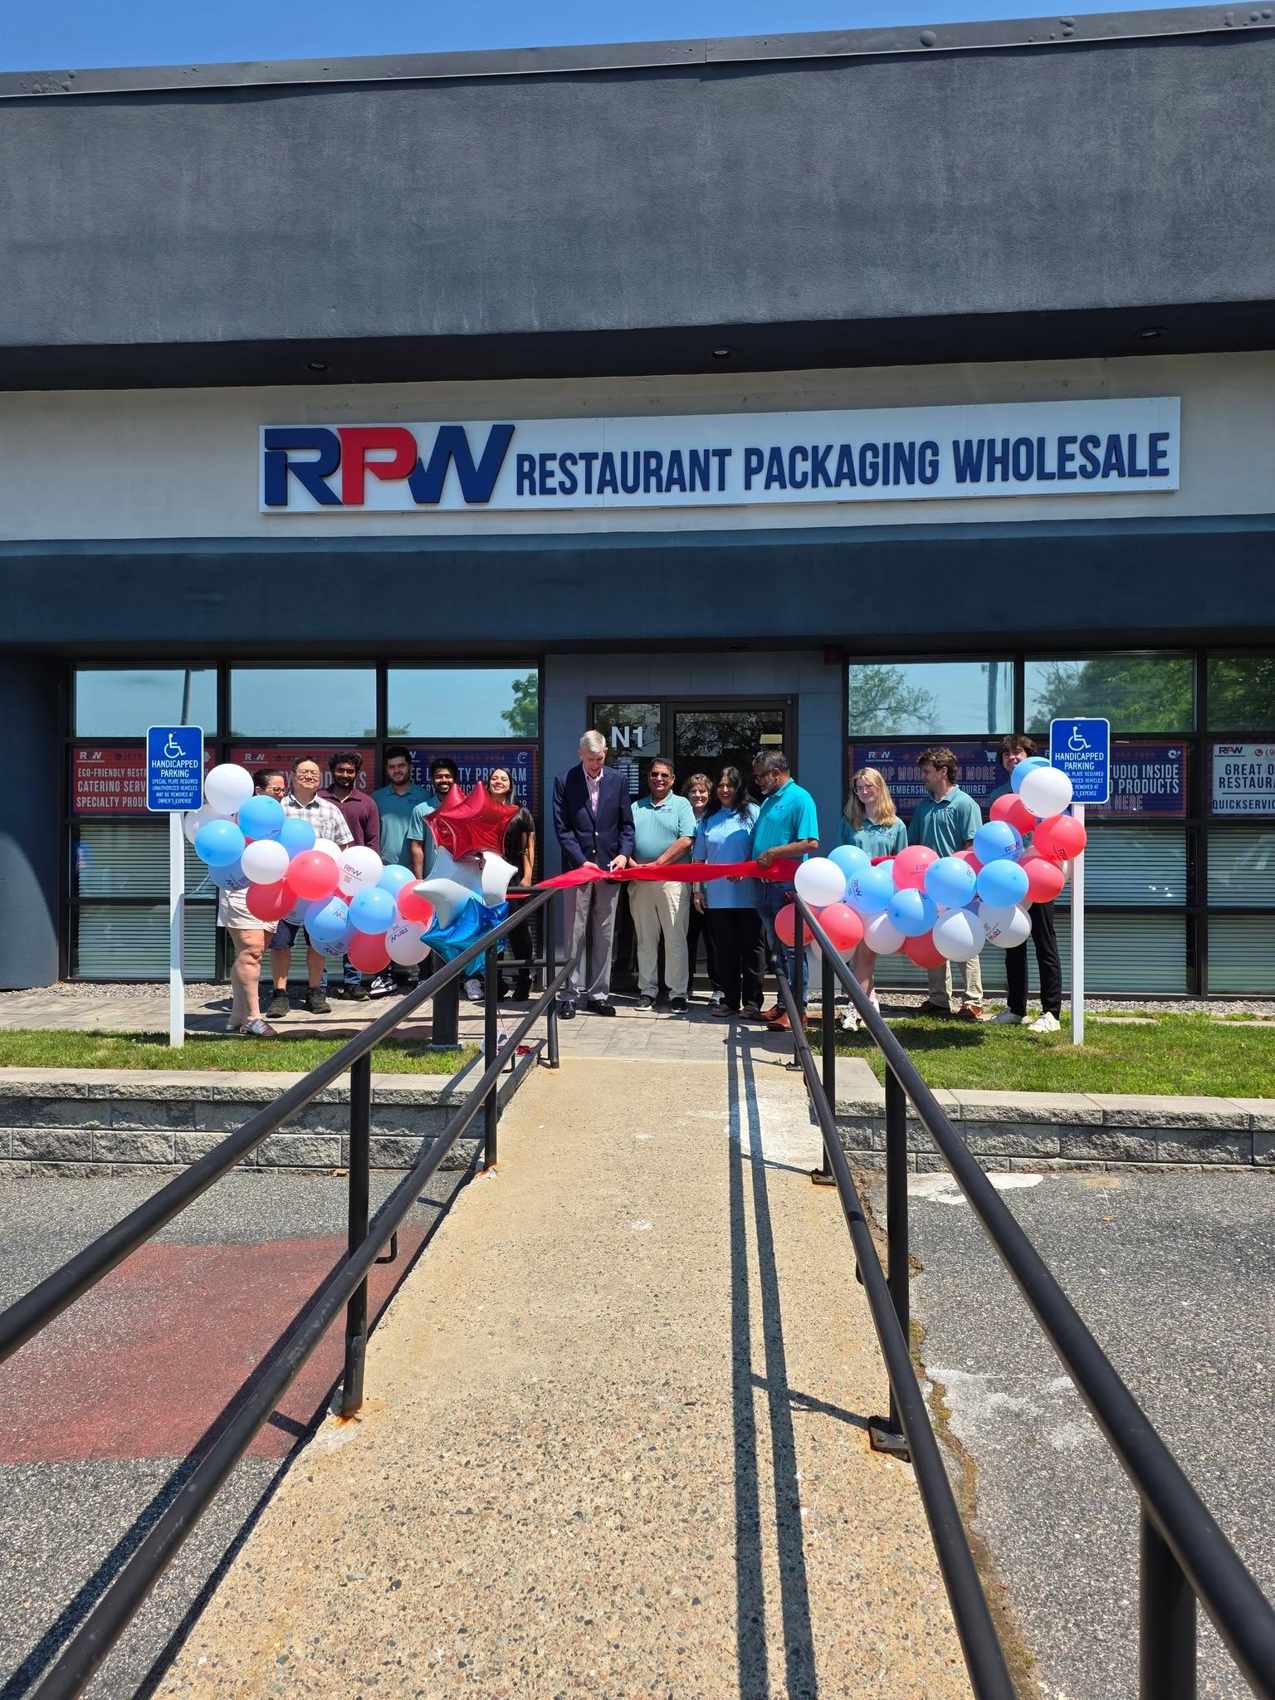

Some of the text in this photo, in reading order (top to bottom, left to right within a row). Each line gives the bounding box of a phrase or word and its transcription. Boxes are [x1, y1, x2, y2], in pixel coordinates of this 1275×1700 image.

[264, 424, 516, 506] RPW
[515, 431, 1170, 496] RESTAURANT PACKAGING WHOLESALE
[611, 725, 643, 748] N1
[1054, 752, 1105, 761] HANDICAPPED
[151, 760, 199, 769] HANDICAPPED
[1064, 762, 1095, 771] PARKING
[1225, 763, 1263, 776] GREAT
[160, 769, 190, 778] PARKING
[1142, 764, 1180, 779] INSIDE
[77, 780, 146, 793] CATERING SERV
[1118, 779, 1180, 795] PRODUCTS
[1218, 776, 1275, 789] RESTAUR
[888, 784, 929, 795] MEMBERSHI
[76, 796, 119, 808] SPECIALTY
